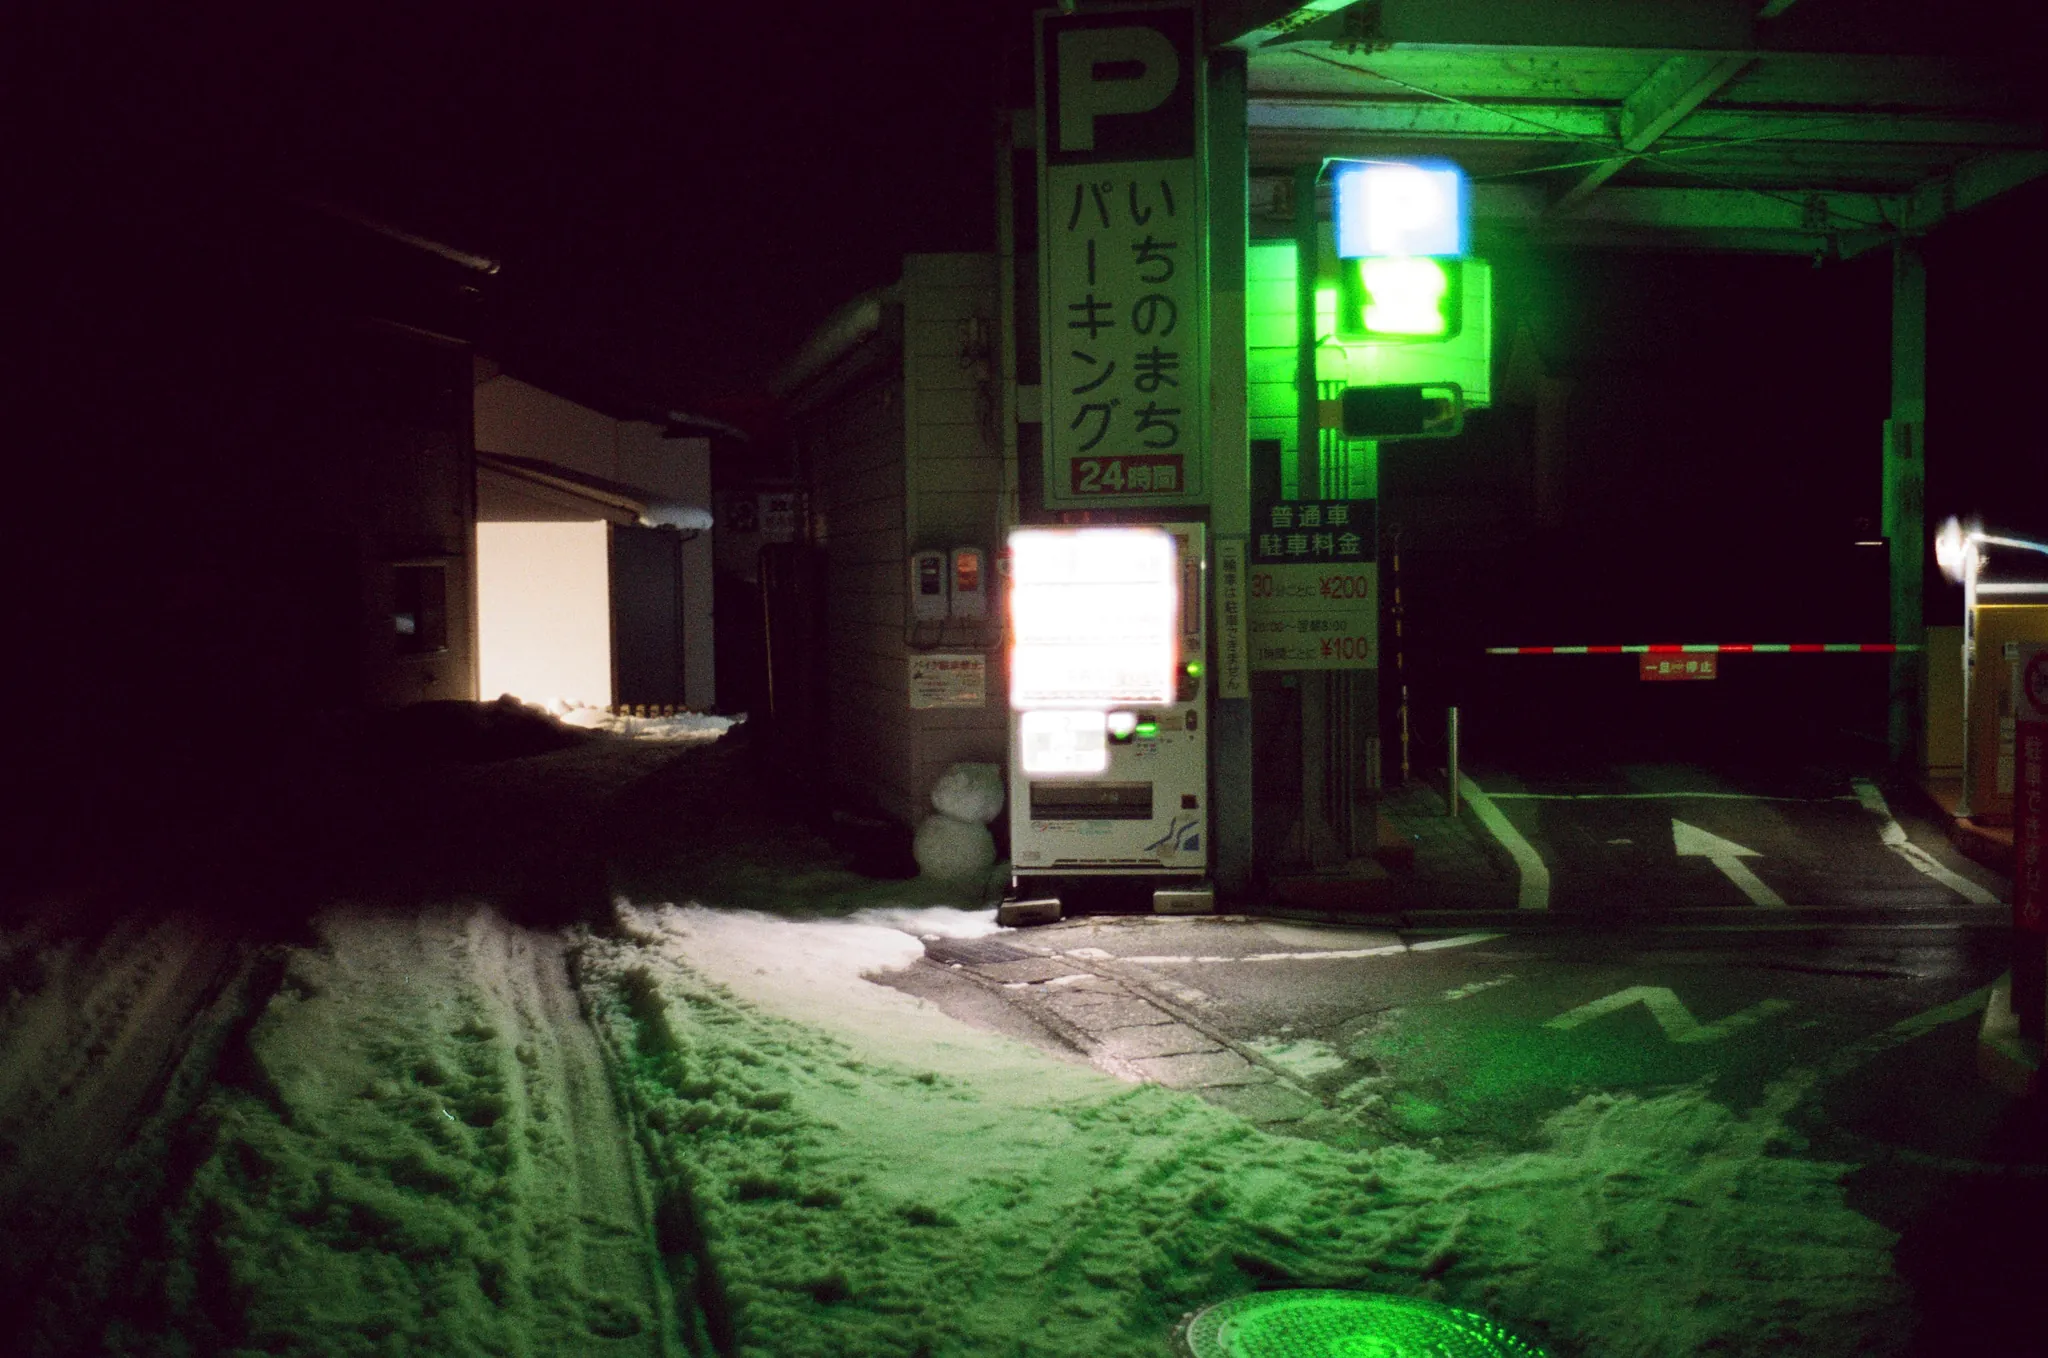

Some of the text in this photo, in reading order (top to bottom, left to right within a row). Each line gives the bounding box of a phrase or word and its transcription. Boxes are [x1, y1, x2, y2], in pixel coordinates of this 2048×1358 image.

[1057, 26, 1181, 152] P
[1067, 182, 1116, 452] パーキング
[1130, 180, 1182, 449] いちのまち
[1078, 459, 1178, 492] 24時間
[1259, 532, 1362, 557] 駐車料金
[1271, 504, 1350, 529] 普通車
